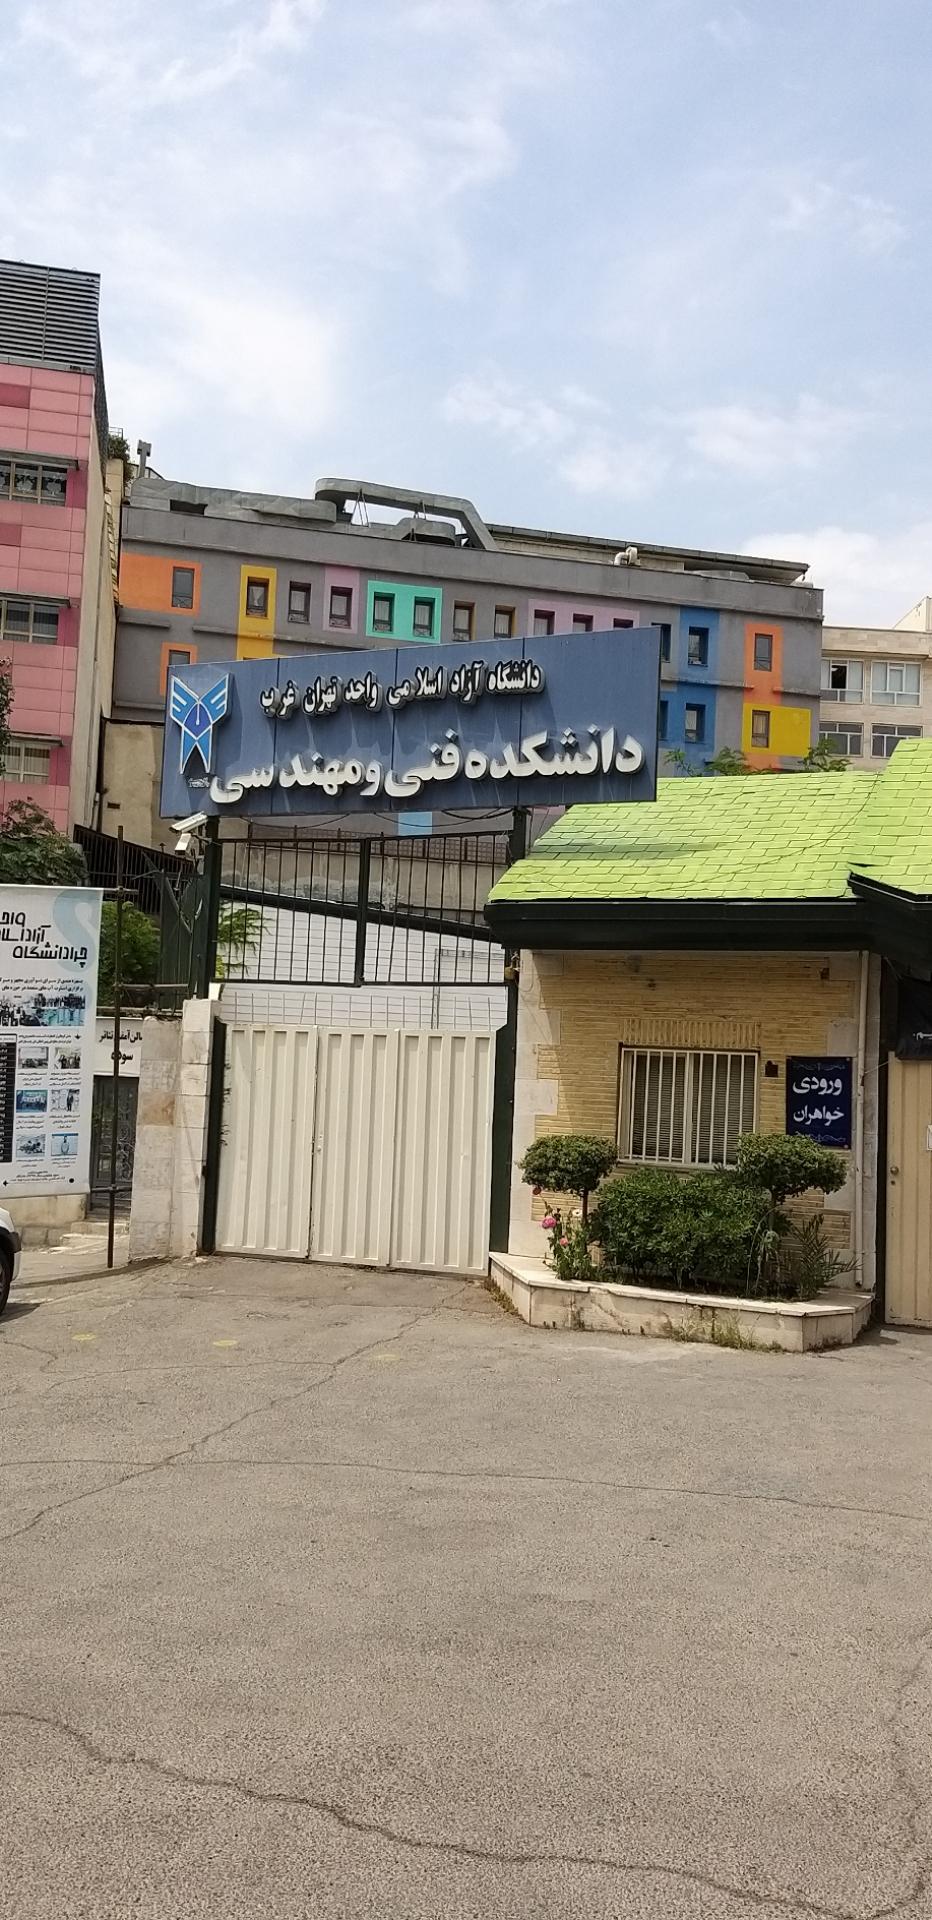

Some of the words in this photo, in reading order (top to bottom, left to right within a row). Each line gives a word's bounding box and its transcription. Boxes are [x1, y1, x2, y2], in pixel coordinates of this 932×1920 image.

[302, 675, 340, 715] تهران
[343, 670, 380, 710] واحد
[386, 665, 446, 707] اسلامی
[450, 660, 484, 703] آزاد
[487, 659, 543, 693] دانشگاه
[260, 680, 298, 718] غرب
[384, 728, 462, 798] فنی
[464, 724, 643, 779] دانشکده
[792, 1076, 843, 1096] ورودی
[793, 1104, 845, 1127] خواهران
